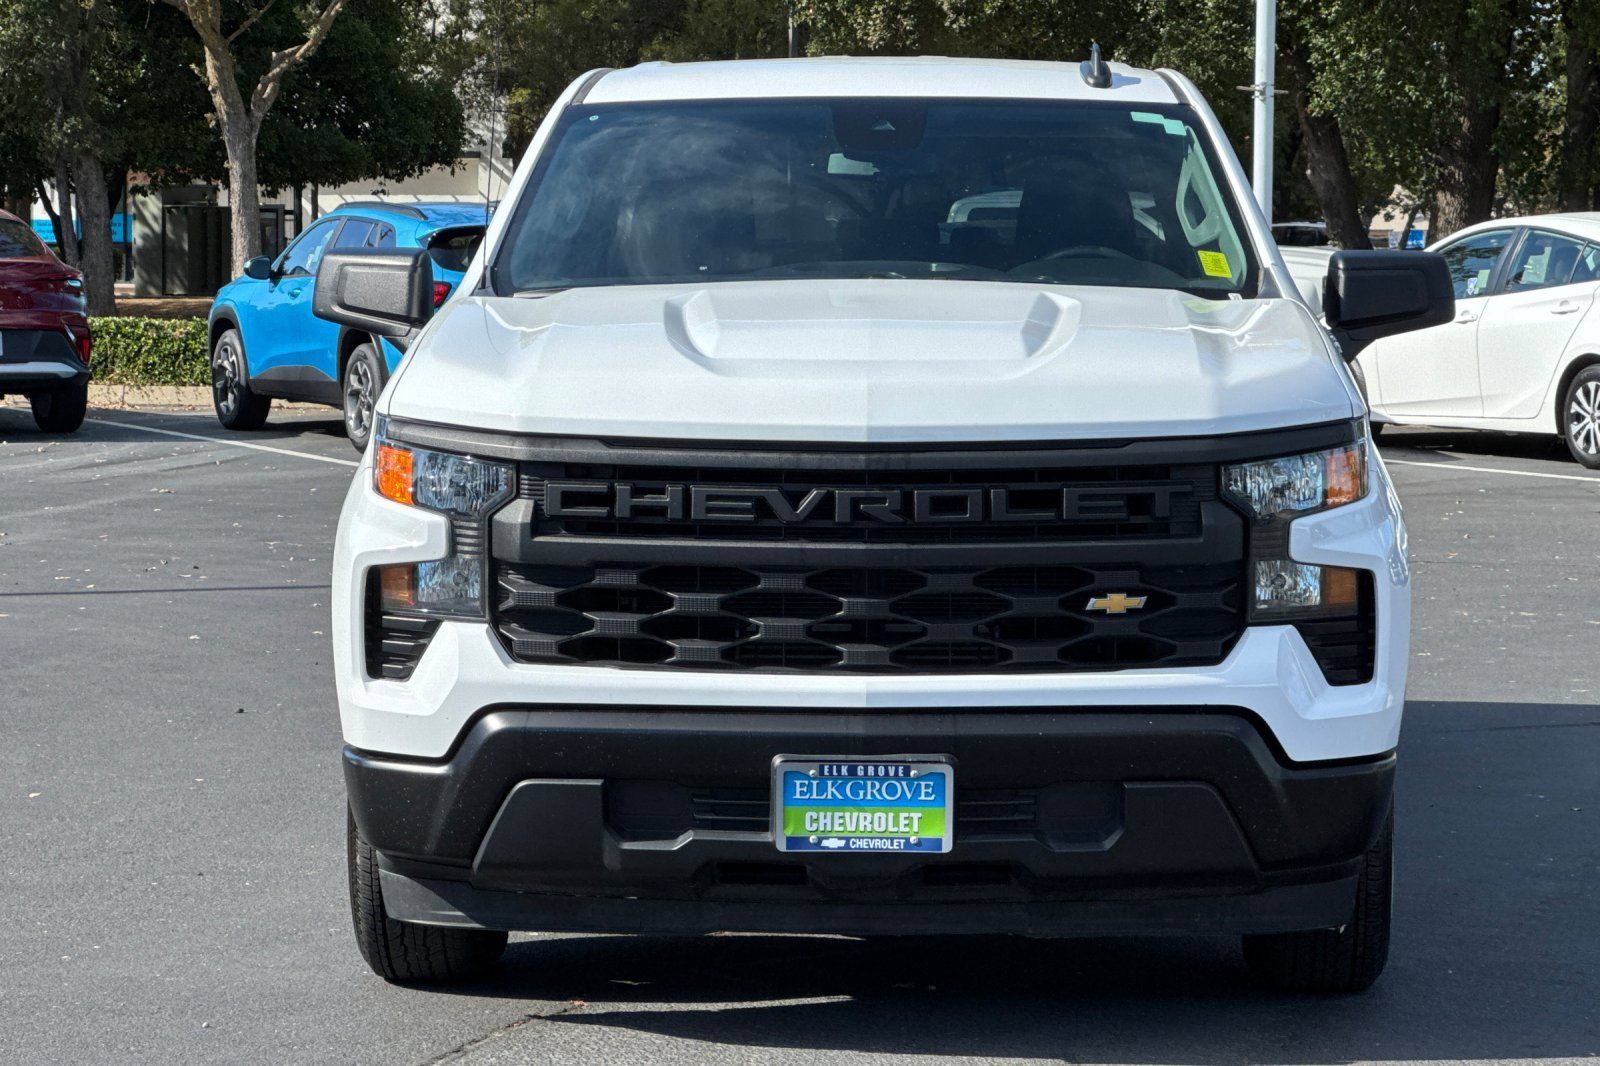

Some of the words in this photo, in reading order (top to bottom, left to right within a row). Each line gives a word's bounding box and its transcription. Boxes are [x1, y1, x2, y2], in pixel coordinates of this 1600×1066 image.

[545, 480, 1193, 524] CHEVROLET
[823, 765, 850, 776] ELK
[857, 765, 905, 777] GROVE
[793, 780, 845, 800] ELK
[845, 780, 936, 801] GROVE
[805, 811, 922, 833] CHEVROLET
[850, 838, 905, 849] CHEVROLET
